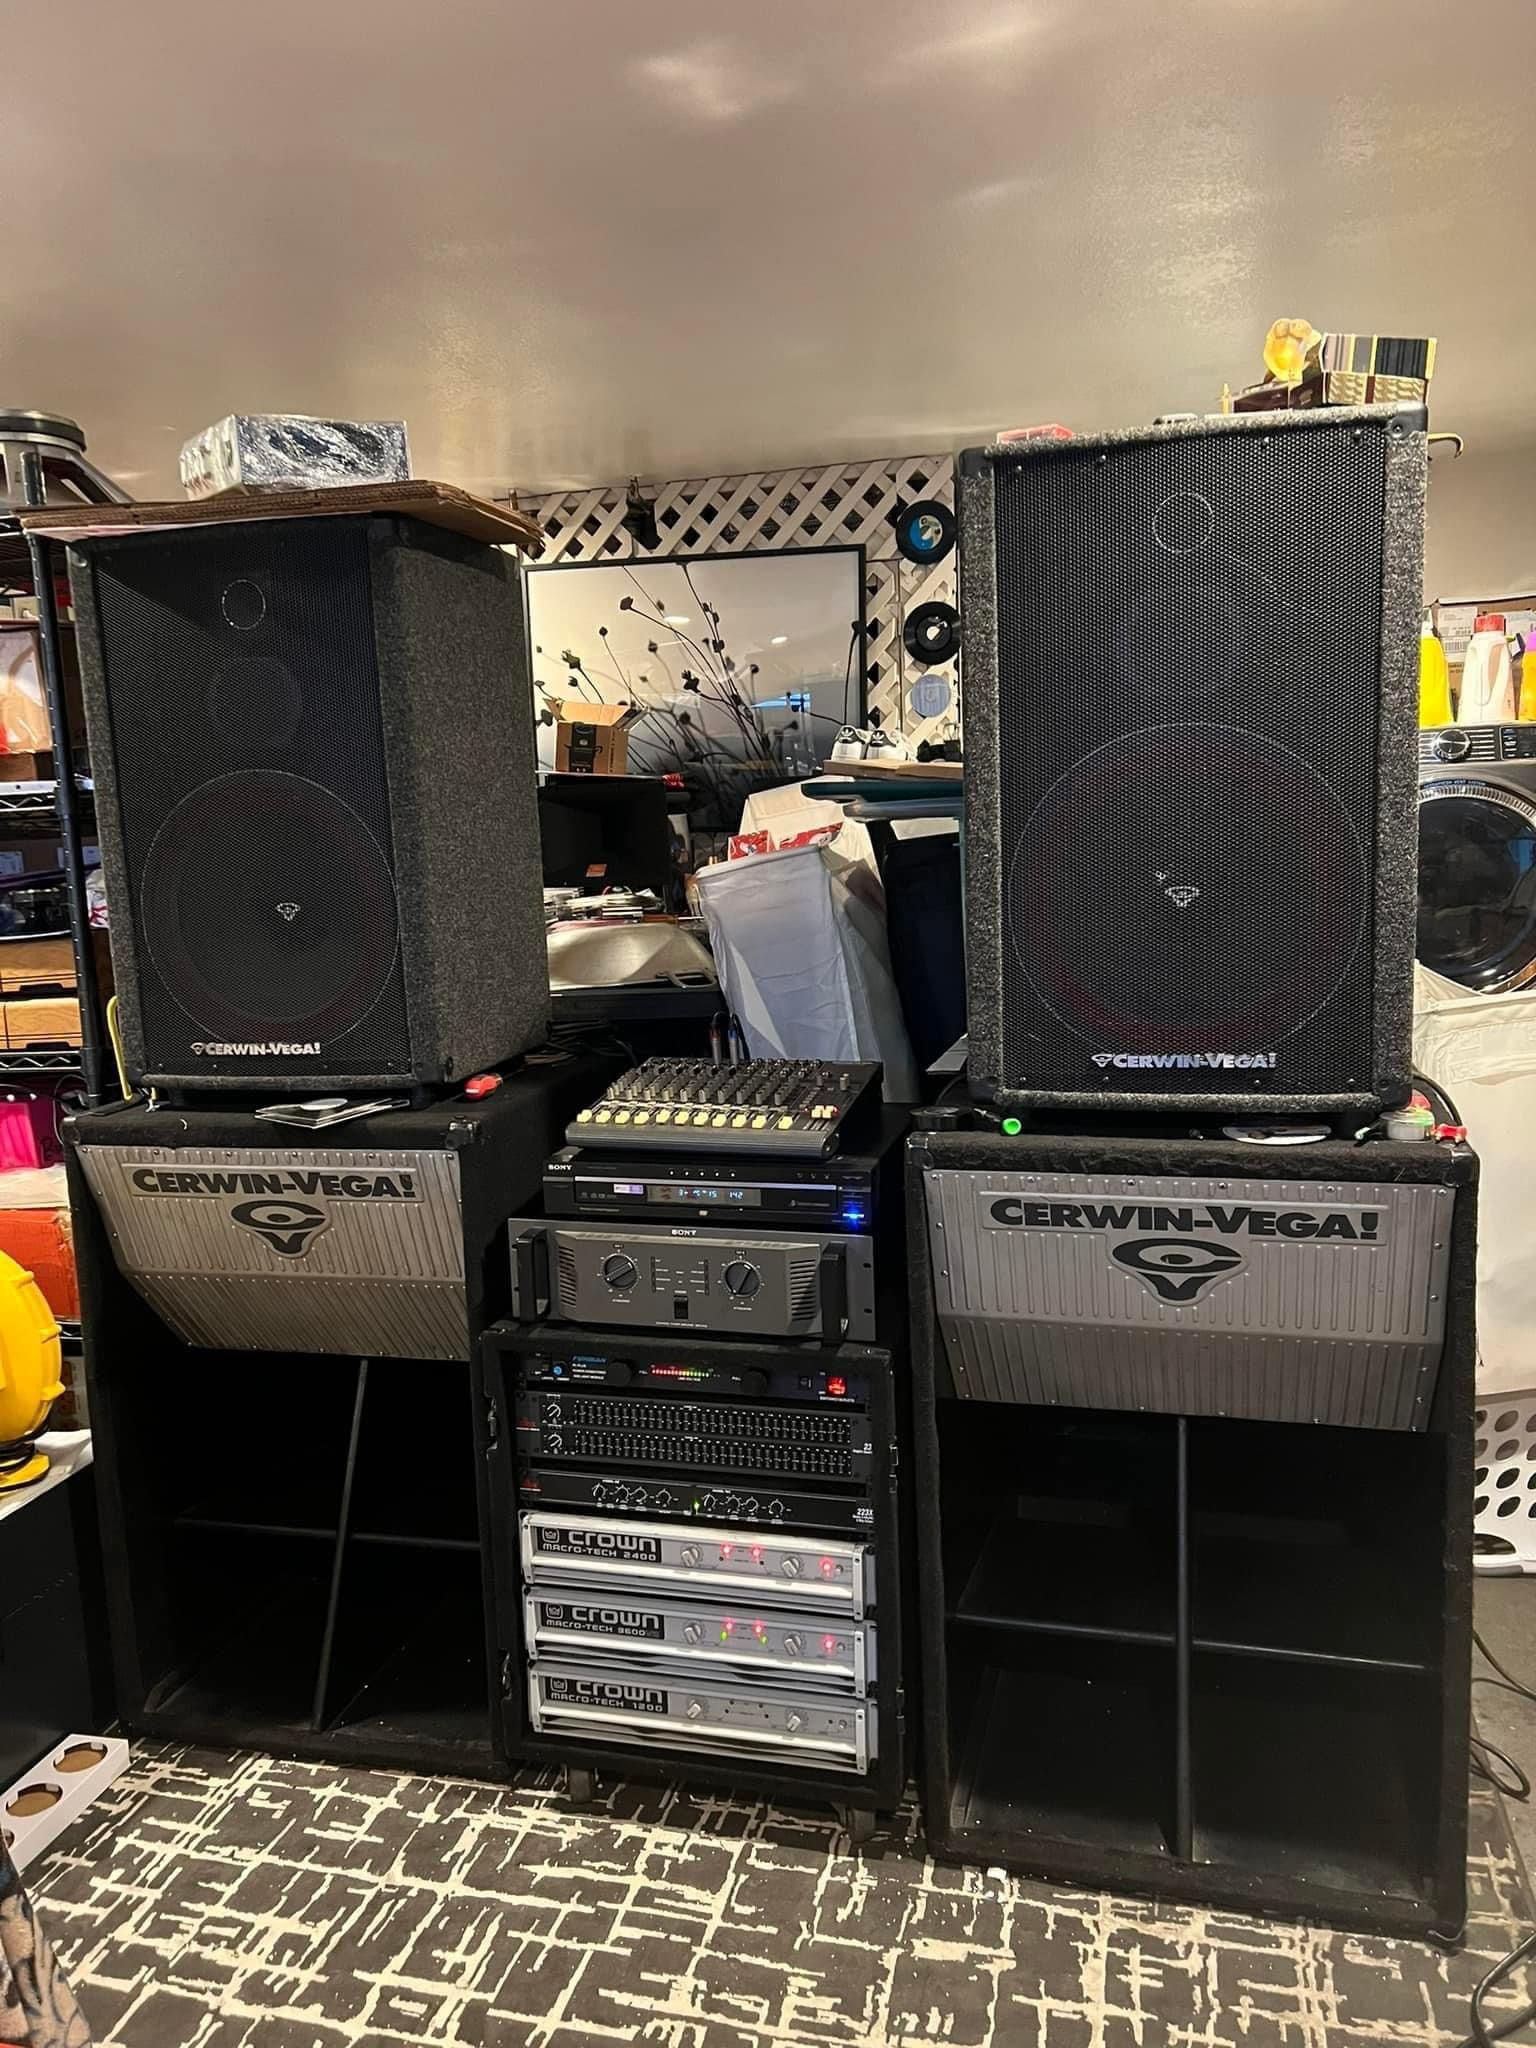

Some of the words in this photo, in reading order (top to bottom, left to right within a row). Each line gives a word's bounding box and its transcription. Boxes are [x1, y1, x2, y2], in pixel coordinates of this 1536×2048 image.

[205, 1041, 321, 1056] CERWIN-VEGA!
[1112, 1052, 1277, 1069] CERWIN-VEGA!
[547, 1163, 573, 1171] SONY
[132, 1168, 417, 1198] CERWIN-VEGA!
[990, 1198, 1379, 1241] CERWIN-VEGA!
[671, 1229, 697, 1237] SONY
[623, 1551, 657, 1561] 2400
[632, 1702, 663, 1713] 1200
